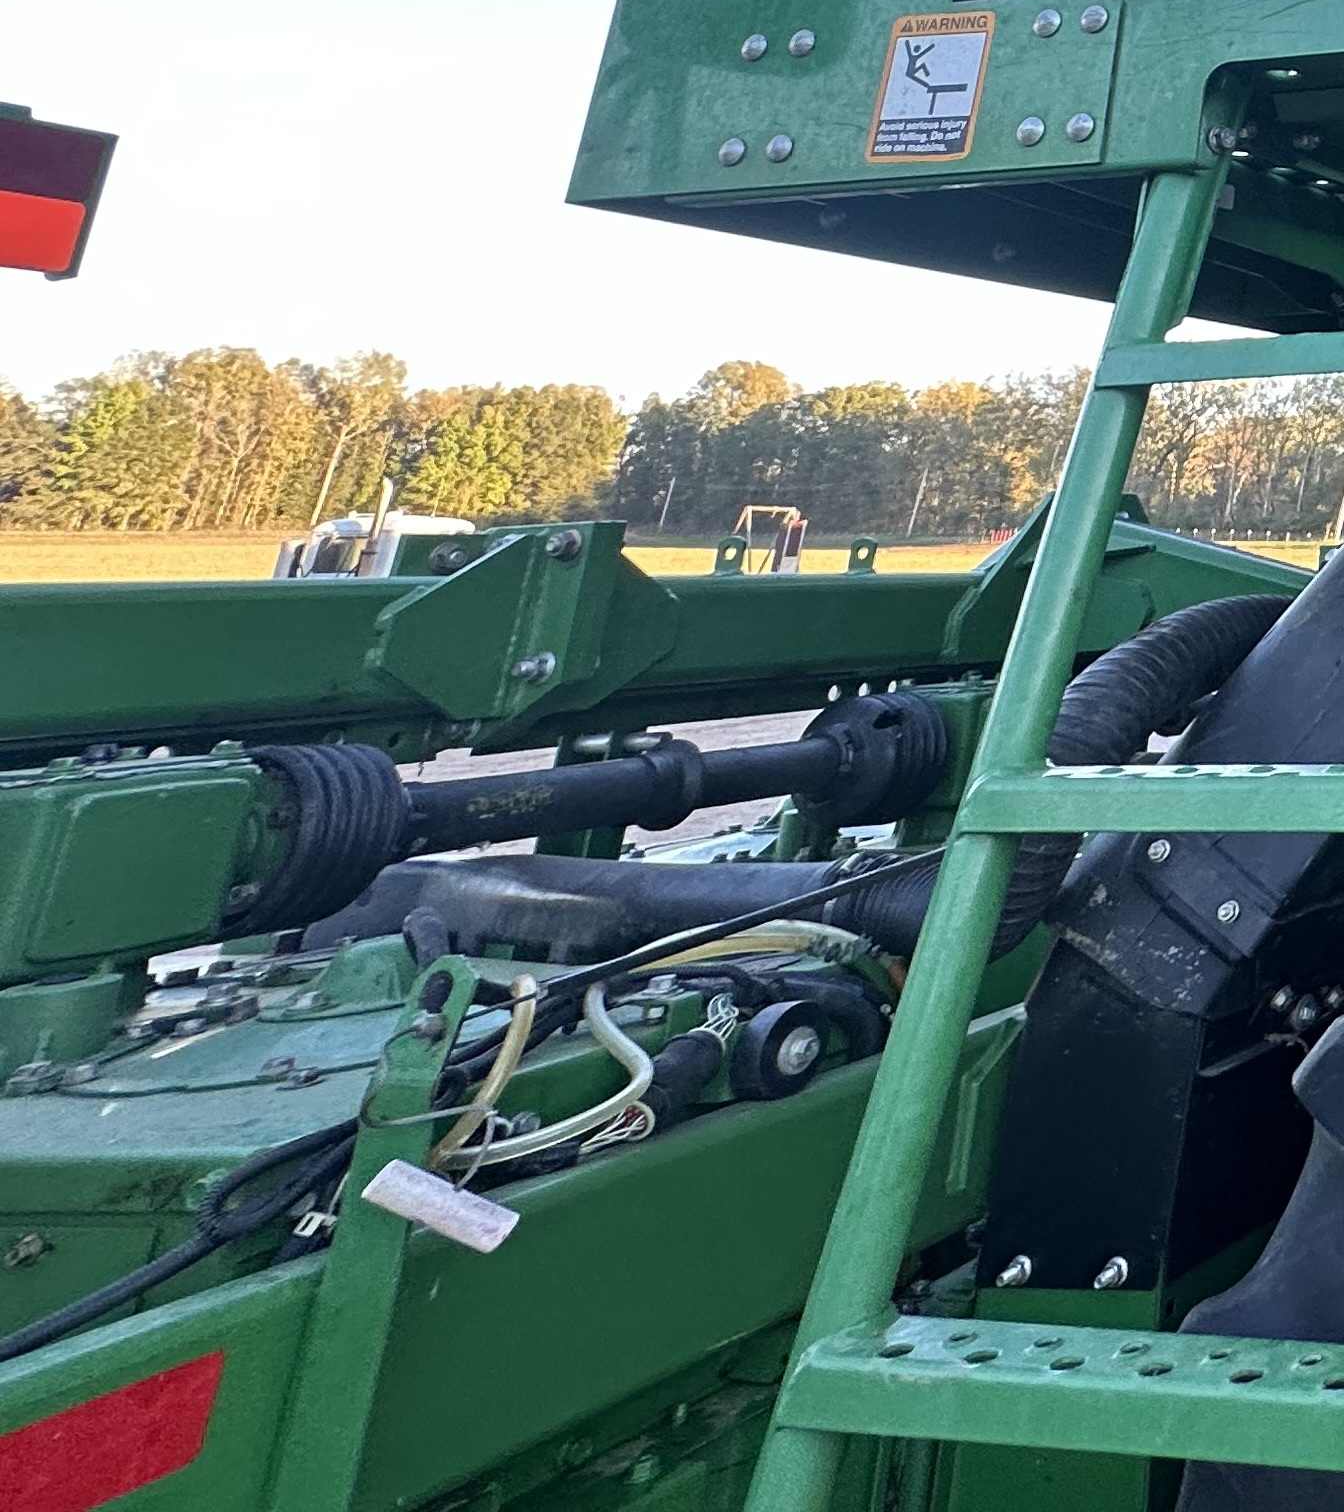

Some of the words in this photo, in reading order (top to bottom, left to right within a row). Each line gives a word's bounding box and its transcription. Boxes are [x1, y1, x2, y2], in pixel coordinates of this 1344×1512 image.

[915, 15, 988, 32] WARNING
[879, 121, 905, 131] Avoid
[940, 119, 967, 131] injury
[930, 130, 944, 141] Do
